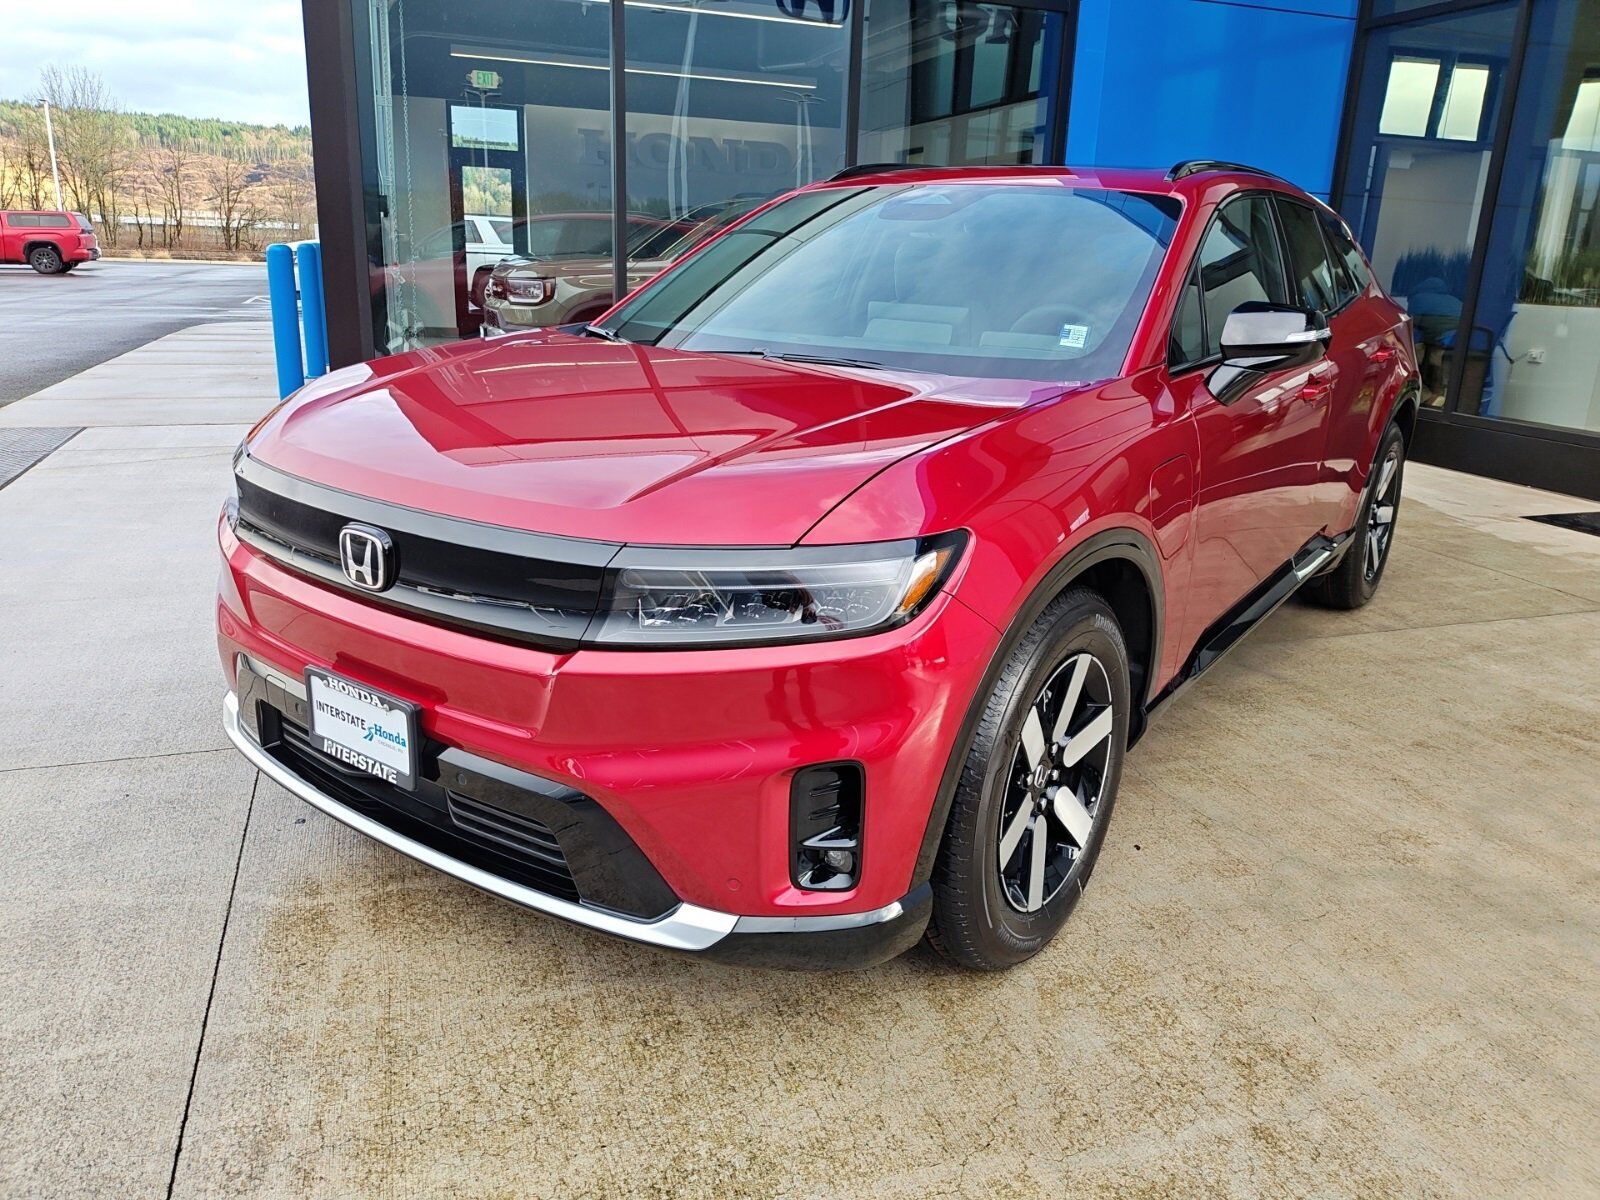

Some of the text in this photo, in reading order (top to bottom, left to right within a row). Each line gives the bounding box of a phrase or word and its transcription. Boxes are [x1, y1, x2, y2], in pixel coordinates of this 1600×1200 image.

[476, 72, 493, 87] EXIT
[326, 676, 383, 708] HONDA
[315, 699, 367, 731] INTERSTATE
[373, 723, 407, 748] Honda
[323, 738, 398, 784] INTERSTATE
